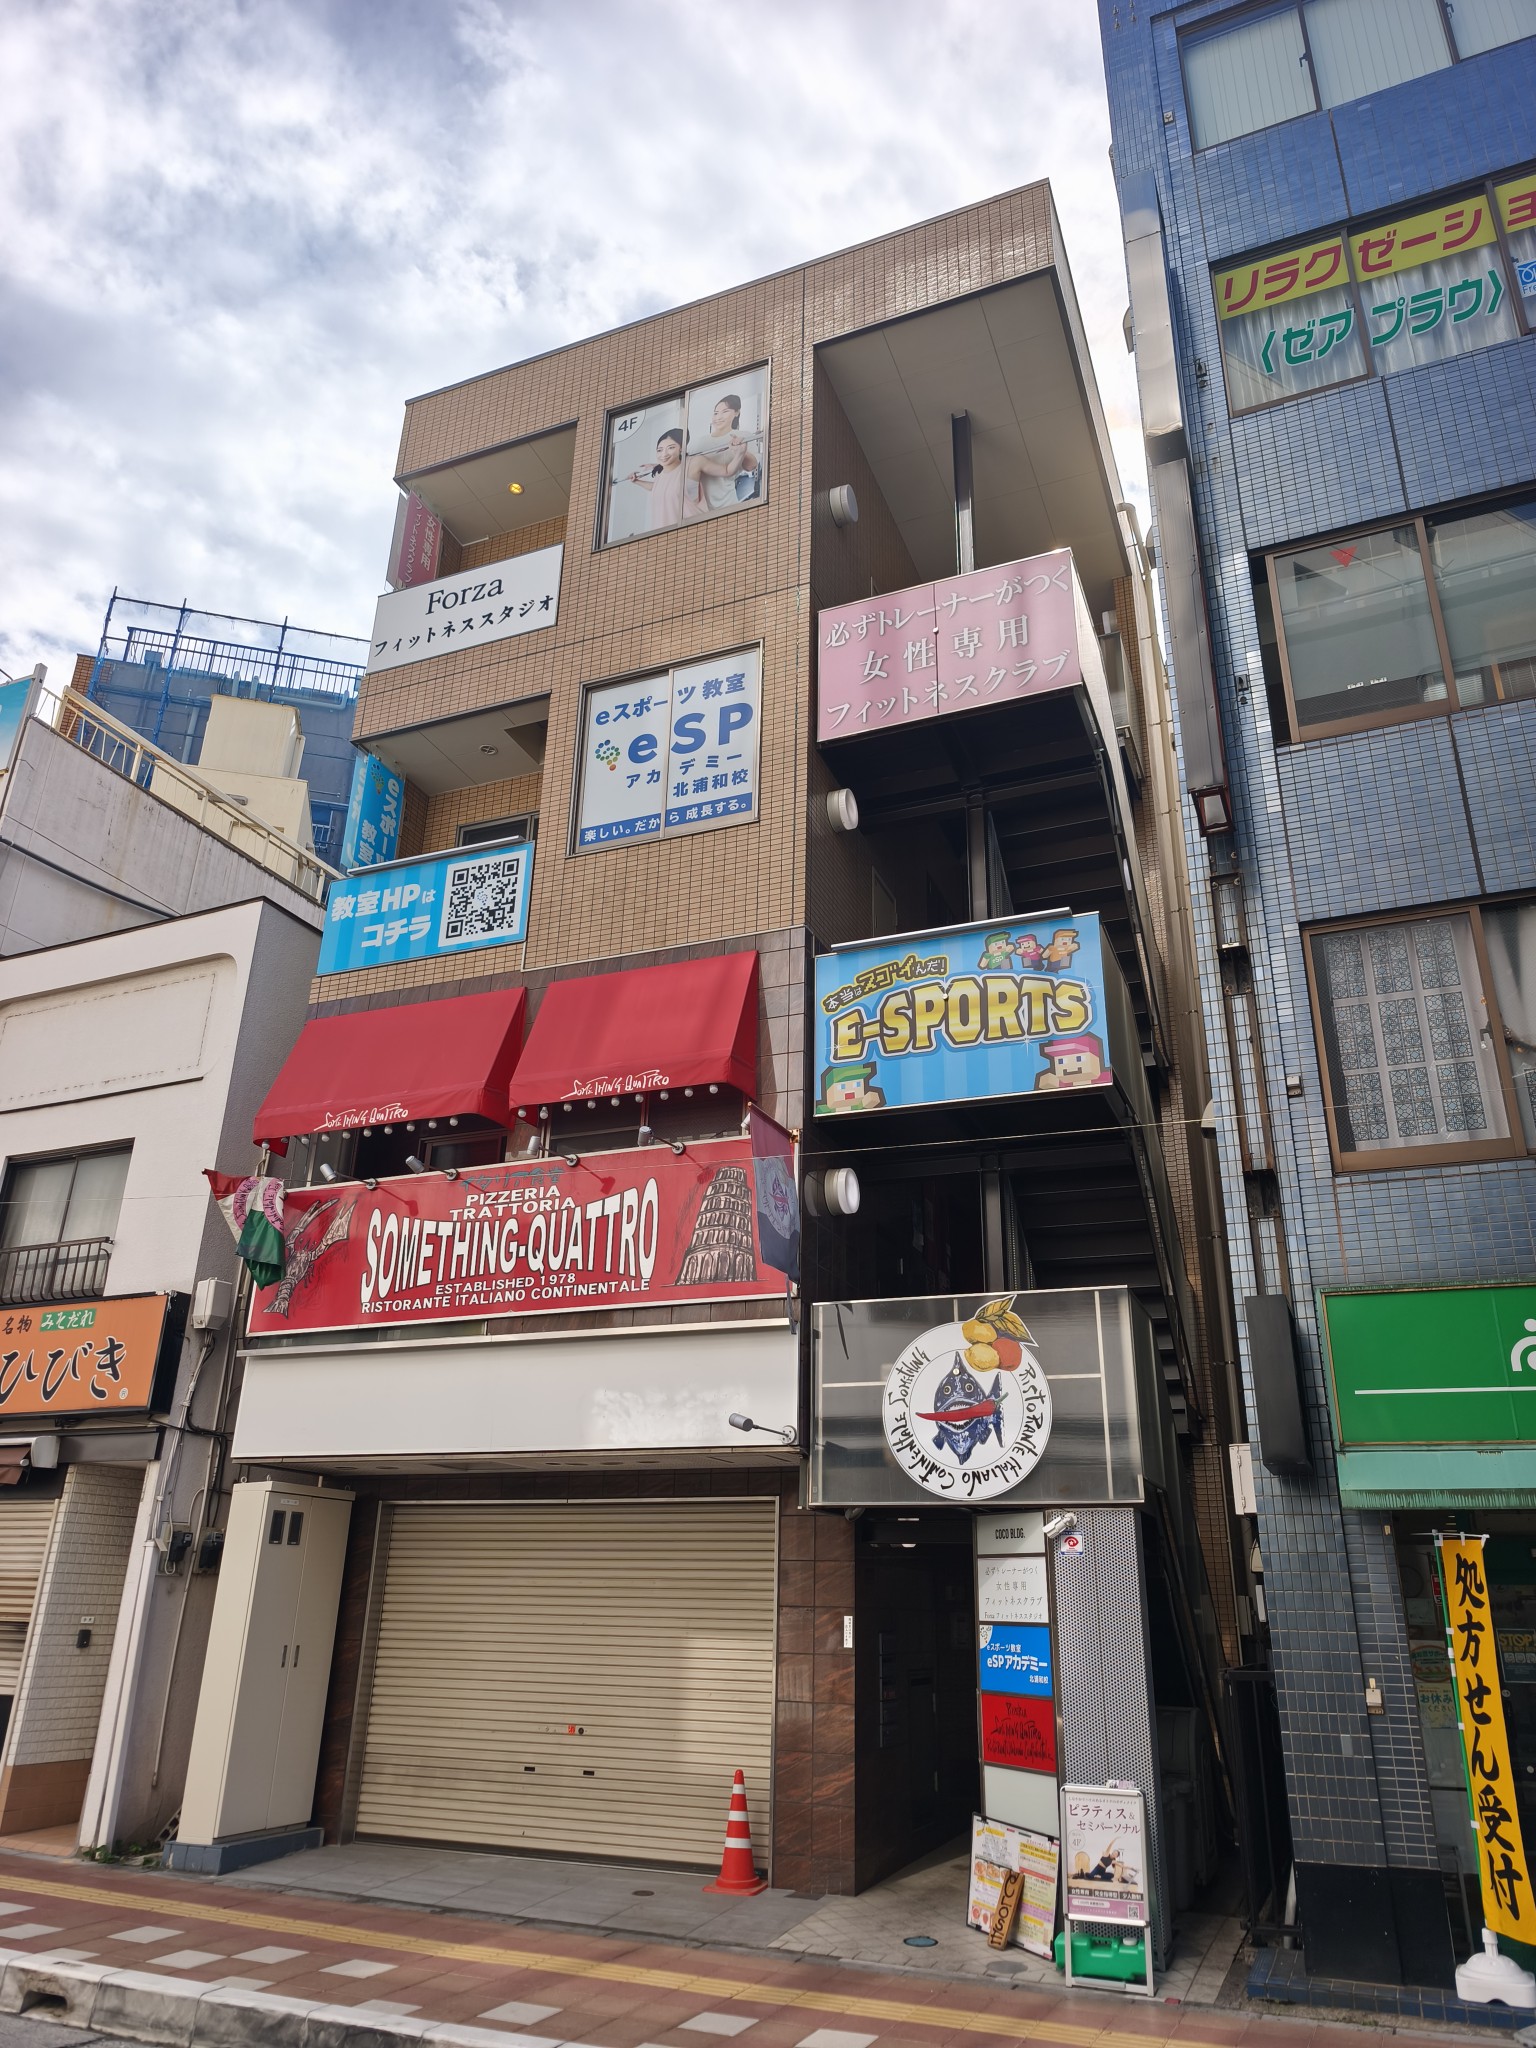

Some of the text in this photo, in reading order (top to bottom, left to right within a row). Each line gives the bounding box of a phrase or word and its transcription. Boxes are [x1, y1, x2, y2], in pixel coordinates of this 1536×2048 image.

[618, 417, 638, 432] 4F
[420, 515, 437, 571] 女性専用
[425, 574, 504, 616] Forza
[825, 565, 1069, 649] 必ずトレーナーがつく
[374, 594, 555, 658] フィットネススタジオ
[859, 614, 1029, 684] 女性専用
[827, 650, 1071, 730] フィットネスクラブ
[627, 702, 754, 764] eSP
[626, 753, 742, 789] アカデミー
[672, 768, 749, 798] 北浦和校
[357, 819, 377, 864] 教室
[331, 883, 437, 922] 教室HPは
[360, 914, 432, 948] コチラ
[832, 975, 1091, 1062] E-SPORTS
[449, 1196, 576, 1221] TRATTORIA
[465, 1185, 561, 1207] PIZZERIA
[361, 1277, 651, 1314] RISTORANTE ITALIANO CONTINENTALE
[435, 1273, 576, 1295] ESTABLISHED 1978
[2, 1309, 95, 1335] 名物 みそだれ
[0, 1335, 127, 1406] ひびき
[995, 1527, 1026, 1540] COCO BLDG.
[987, 1655, 1048, 1672] eSPアカデミー
[1455, 1552, 1524, 1921] 処方せん受付
[1069, 1803, 1127, 1820] ピラティス
[1077, 1820, 1141, 1834] セミパーソナル
